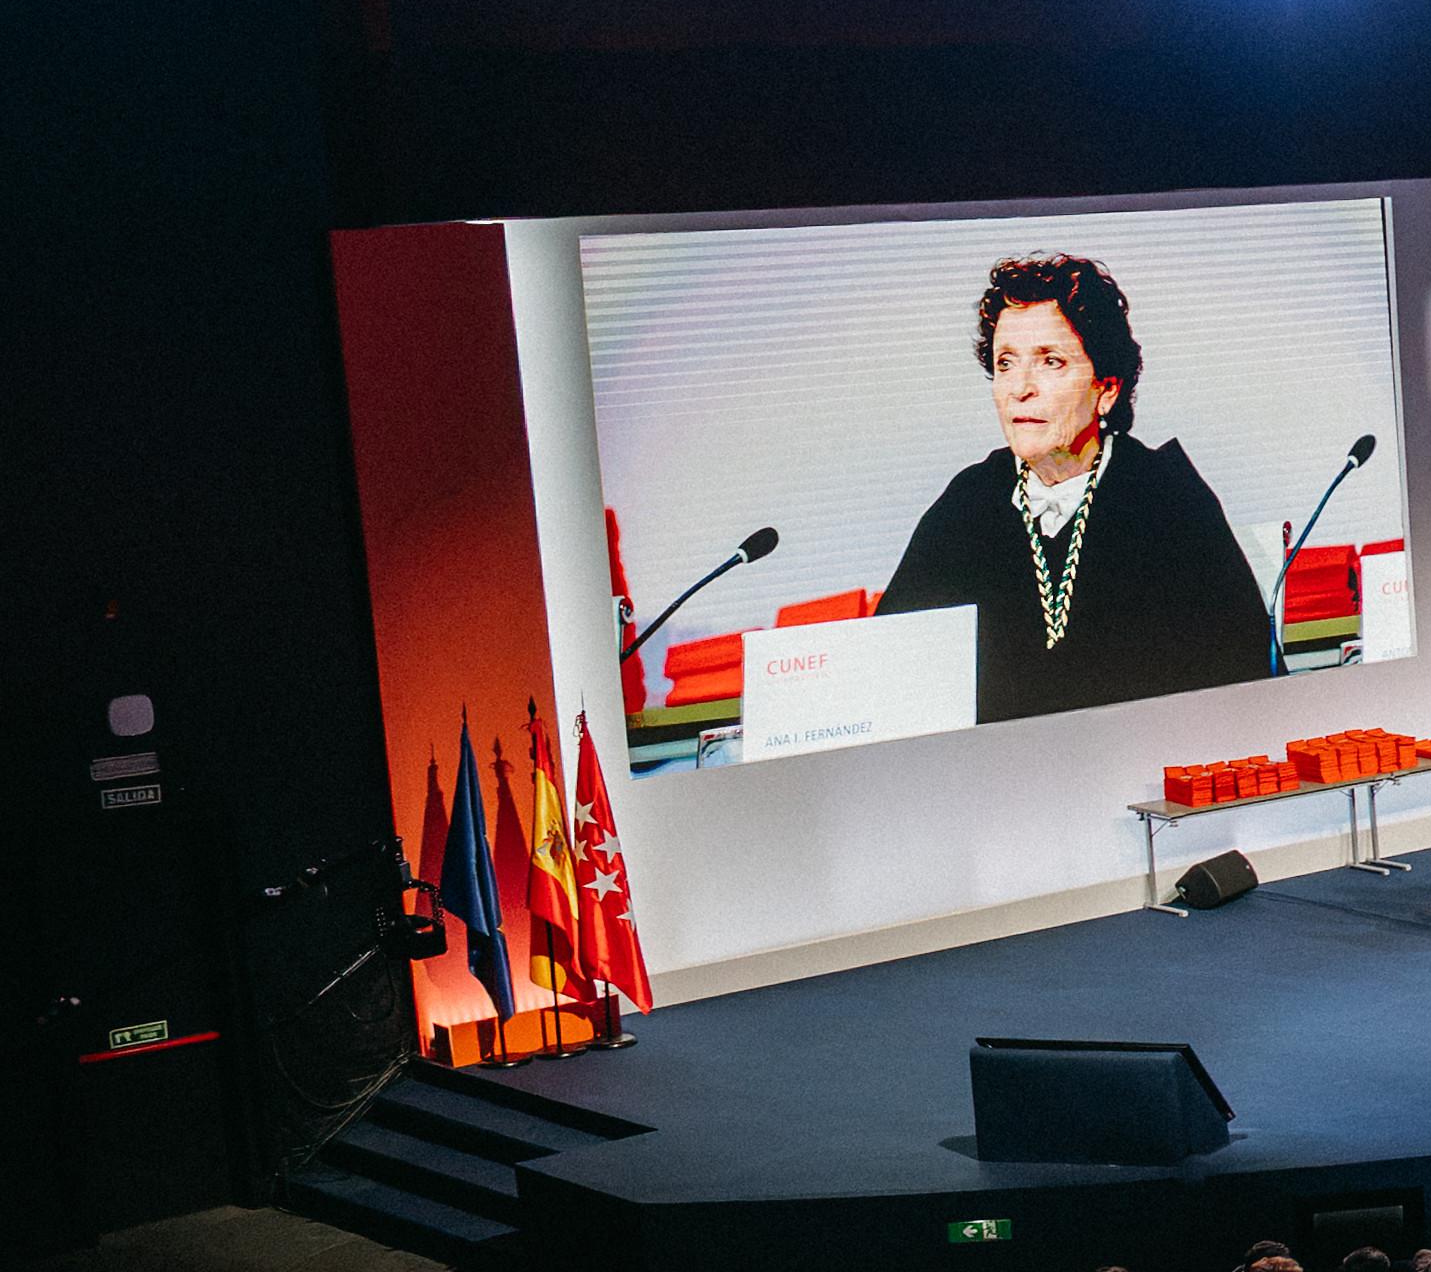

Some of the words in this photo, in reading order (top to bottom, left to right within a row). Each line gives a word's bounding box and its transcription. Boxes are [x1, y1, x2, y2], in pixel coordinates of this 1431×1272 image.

[766, 653, 829, 676] CUNEF
[764, 734, 791, 749] ANA
[804, 721, 874, 742] FERNÁNDEZ
